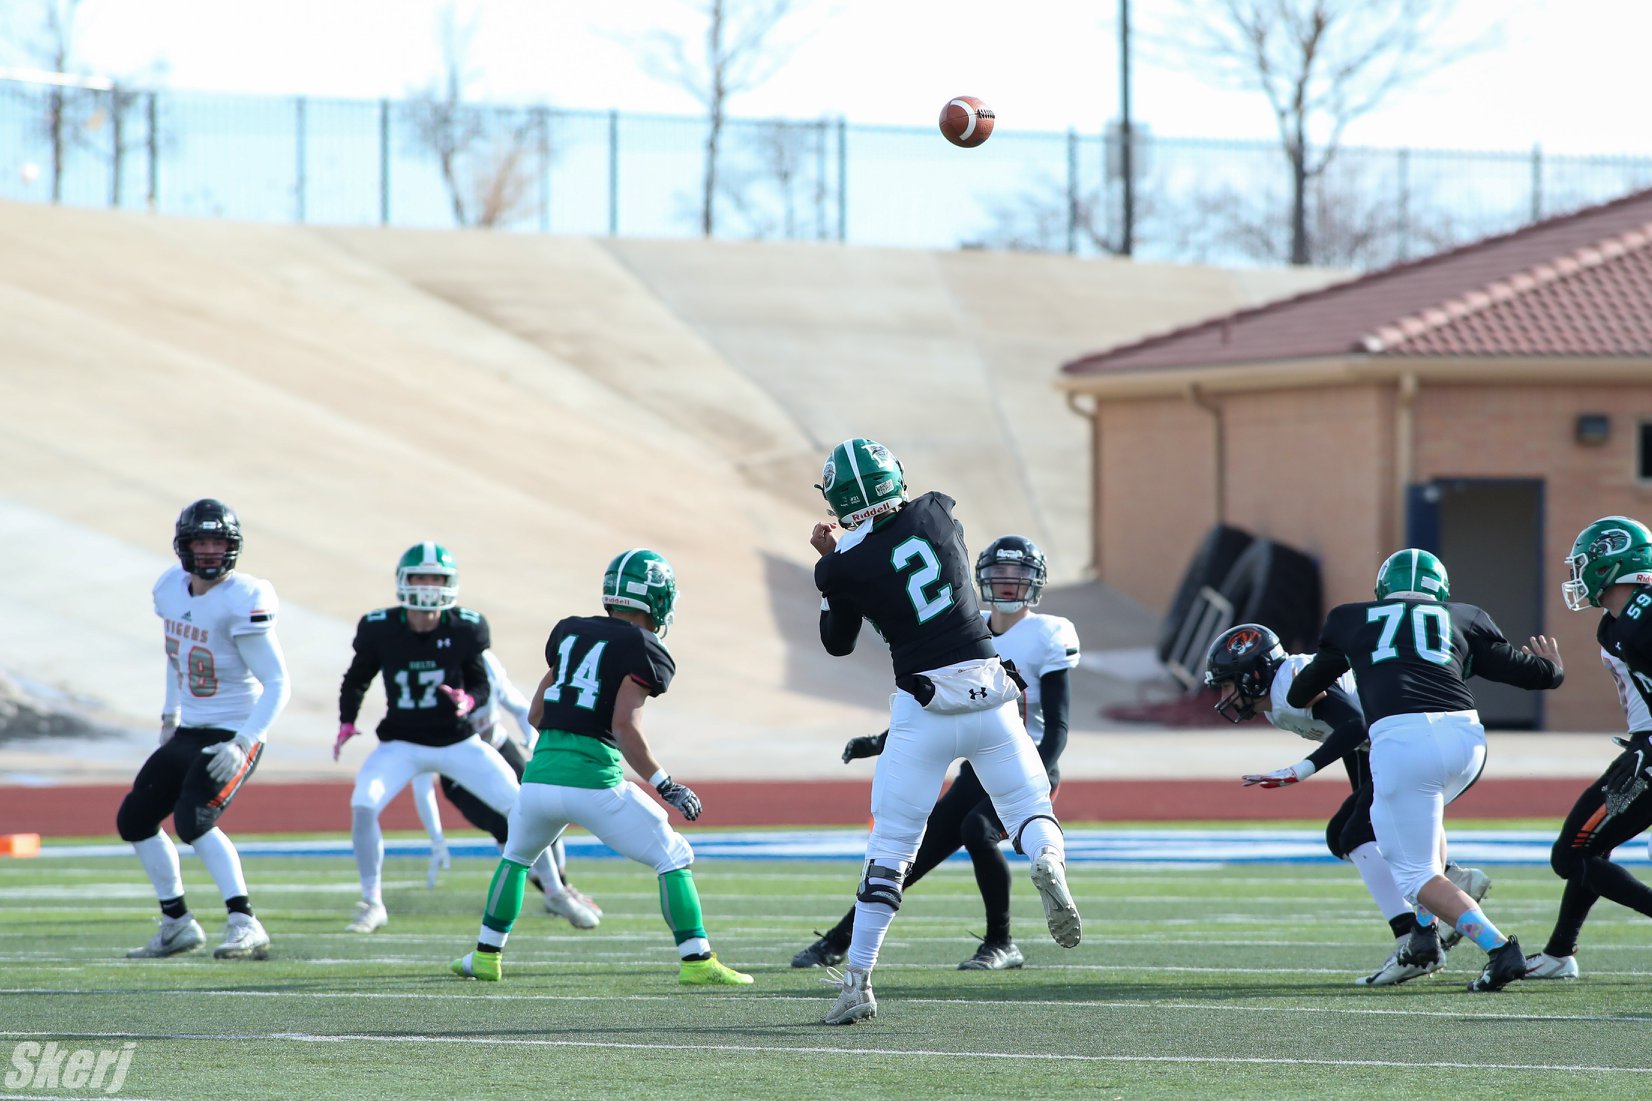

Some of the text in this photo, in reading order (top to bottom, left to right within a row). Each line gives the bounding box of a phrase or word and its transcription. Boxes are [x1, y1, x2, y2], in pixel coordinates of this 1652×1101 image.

[852, 503, 890, 521] Riddell
[890, 535, 954, 625] 2
[605, 596, 630, 606] Riddell
[1626, 593, 1652, 620] 59
[164, 619, 209, 644] TIGERS
[1366, 602, 1452, 664] 70
[394, 669, 445, 709] 17
[543, 634, 608, 711] 14
